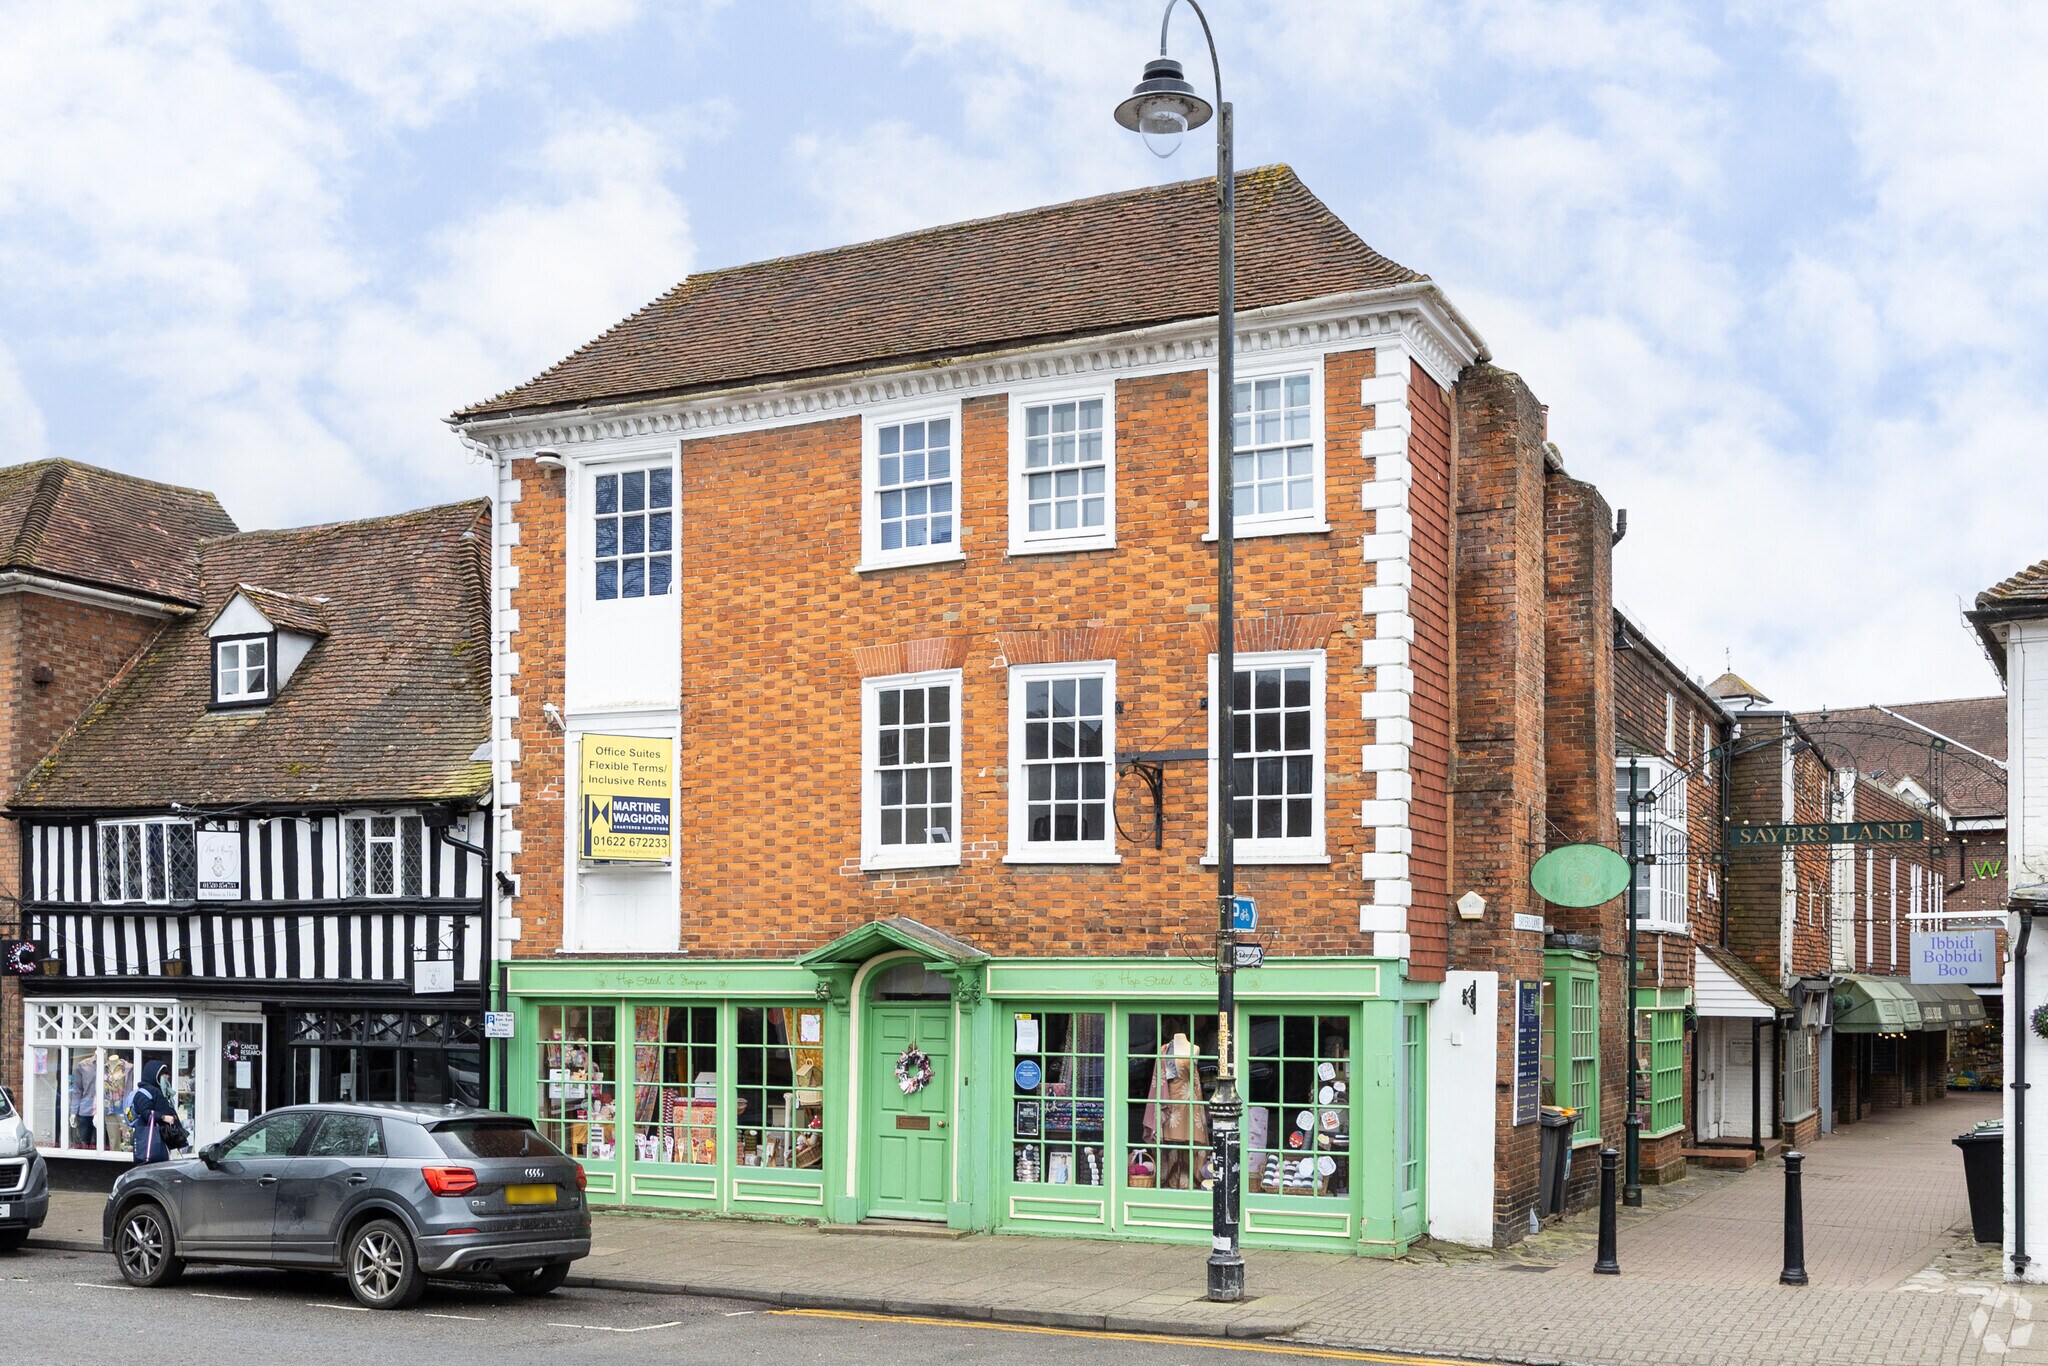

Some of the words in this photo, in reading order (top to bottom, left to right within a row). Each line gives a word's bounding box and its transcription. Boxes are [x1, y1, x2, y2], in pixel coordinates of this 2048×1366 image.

[596, 746, 626, 757] Office
[629, 748, 661, 759] Suites
[589, 760, 629, 771] Flexible
[632, 762, 667, 773] Terms/
[588, 775, 635, 786] Inclusive
[638, 777, 667, 787] Rents
[613, 801, 661, 813] MARTINE
[613, 812, 669, 825] WAGHORN
[1740, 825, 1830, 844] SAYERS
[1842, 823, 1914, 841] LANE
[593, 835, 626, 846] 01622
[629, 837, 668, 848] 672233
[1931, 935, 1975, 950] Ibbidi
[1924, 949, 1983, 963] Bobbidi
[1937, 963, 1968, 976] Boo
[616, 971, 634, 988] Hop
[636, 975, 661, 987] Stitch
[667, 974, 675, 985] &
[1119, 970, 1140, 988] Hop
[1144, 974, 1175, 988] Stitch
[1182, 974, 1192, 987] &
